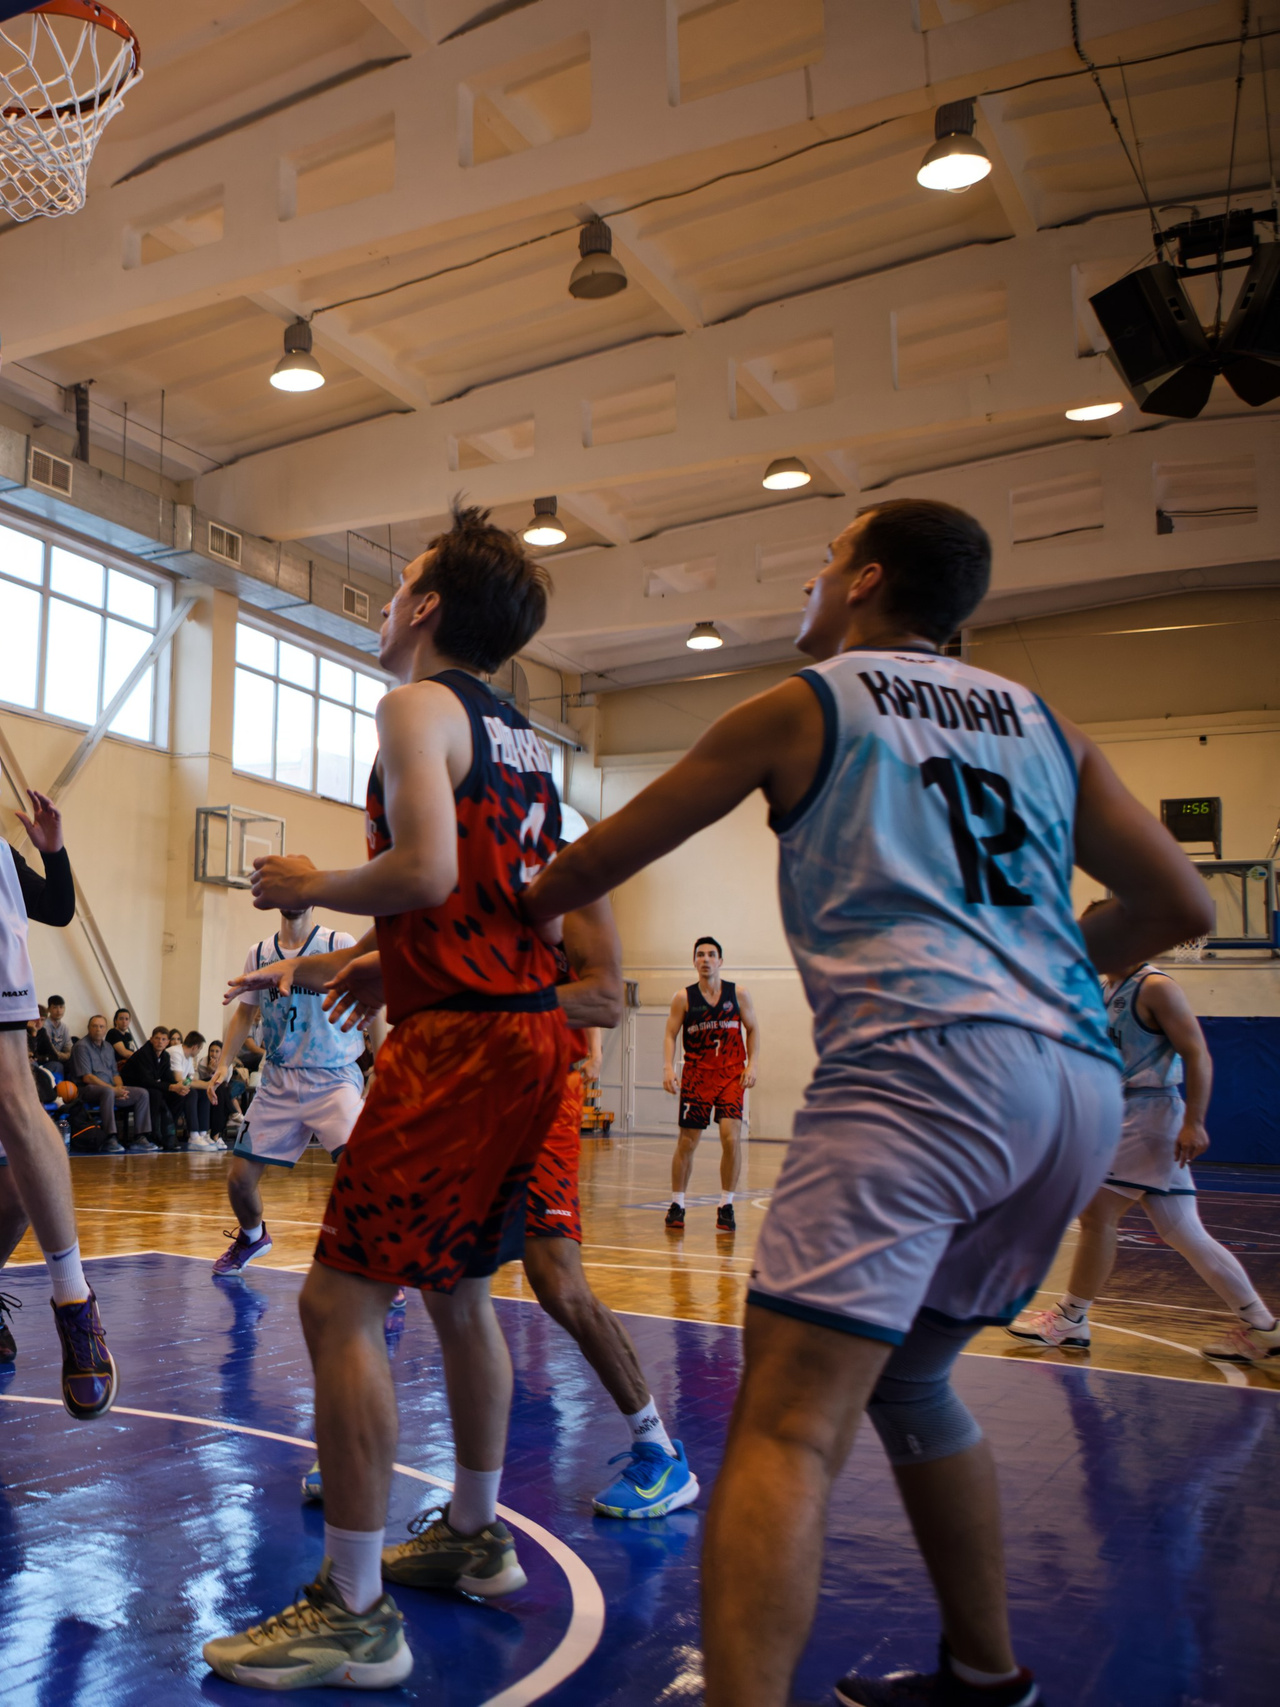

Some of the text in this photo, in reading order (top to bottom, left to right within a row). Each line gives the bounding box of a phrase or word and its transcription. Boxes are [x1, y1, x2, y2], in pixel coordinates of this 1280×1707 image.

[857, 670, 1024, 738] КАПЛАН
[1182, 802, 1209, 815] 1:56
[920, 756, 1034, 906] 12
[1, 989, 28, 998] MAXX
[288, 1006, 297, 1032] 7
[713, 1039, 721, 1057] 7
[683, 1103, 690, 1120] 7
[239, 1120, 250, 1144] 7
